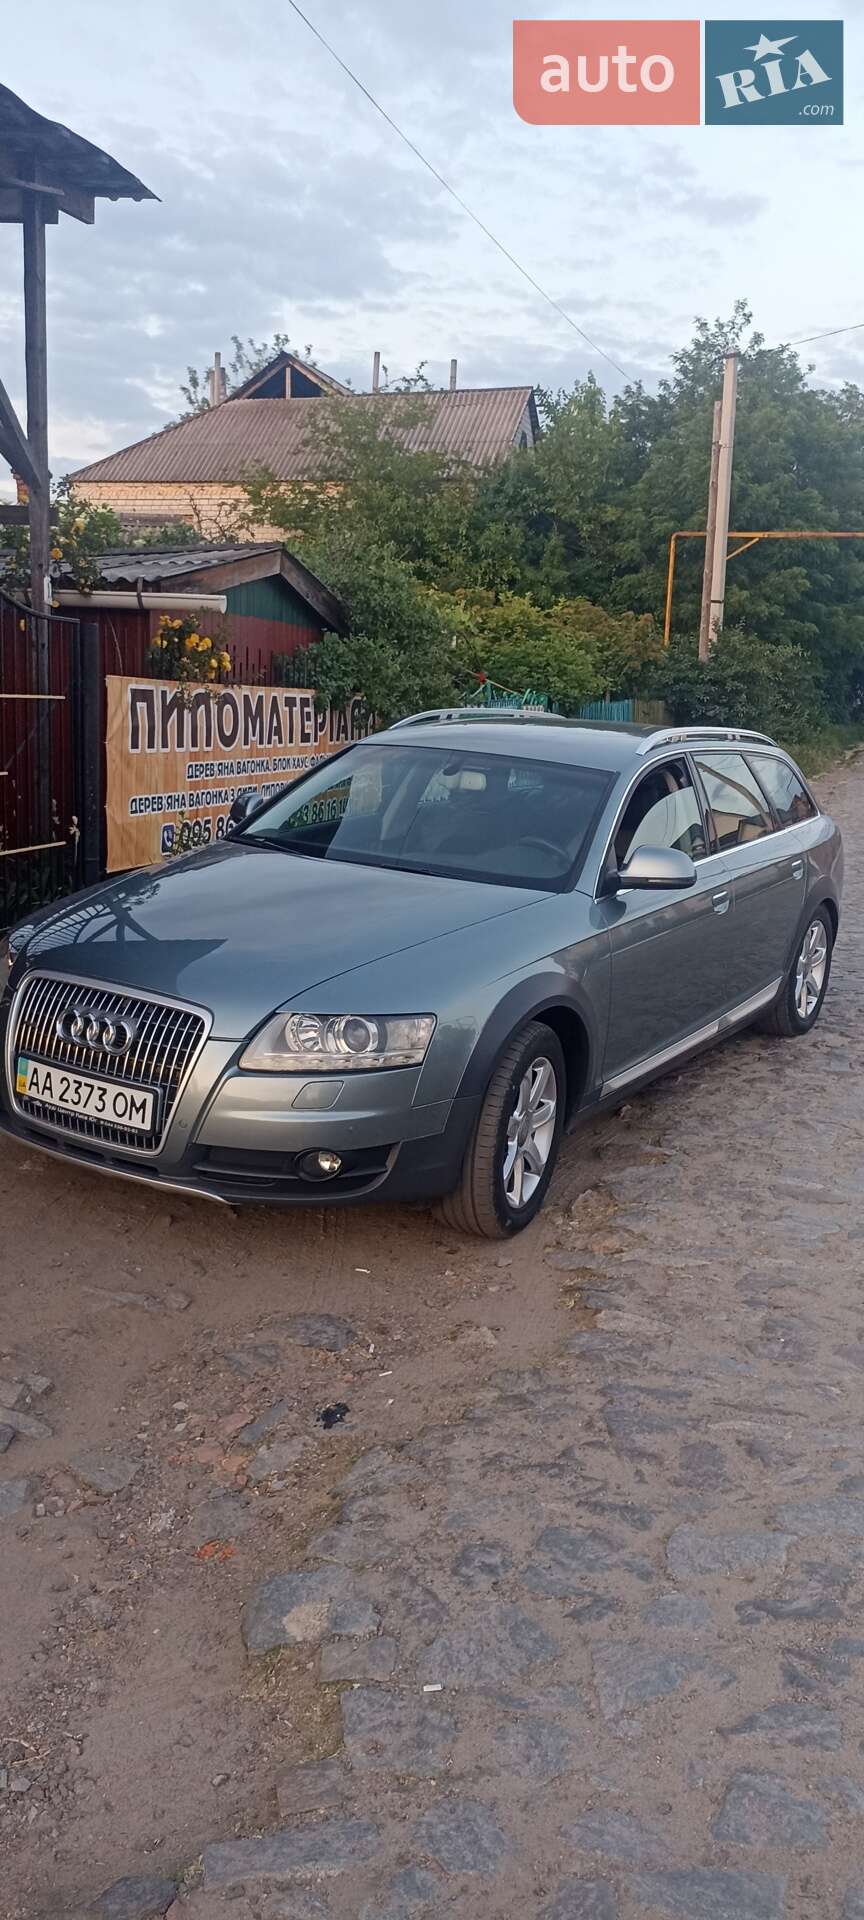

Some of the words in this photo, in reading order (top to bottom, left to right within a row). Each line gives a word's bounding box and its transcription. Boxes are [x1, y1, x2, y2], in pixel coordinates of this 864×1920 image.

[272, 757, 290, 771] БЛОК
[130, 794, 187, 815] ДЕРЕВ'ЯНА
[188, 787, 229, 808] ВАГОНКА
[28, 1068, 54, 1099] AA
[59, 1076, 107, 1113] 2373
[113, 1092, 147, 1124] OM
